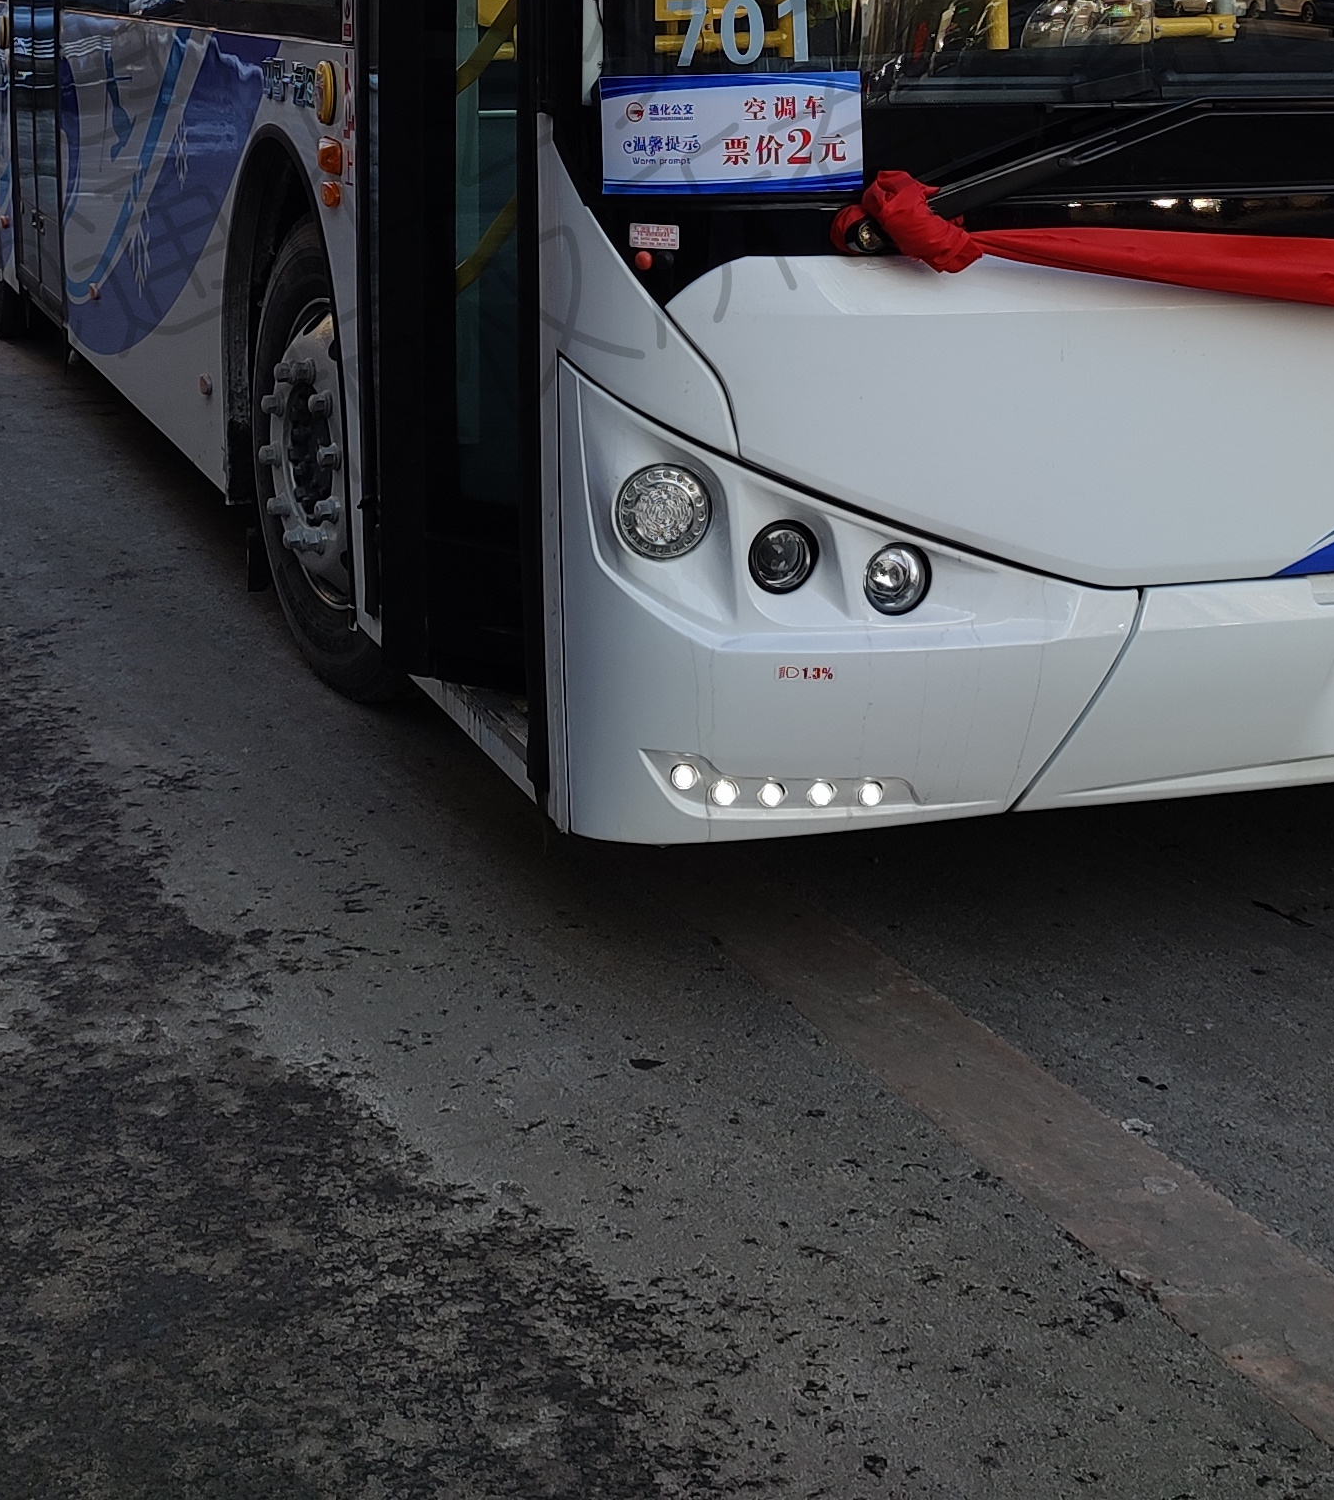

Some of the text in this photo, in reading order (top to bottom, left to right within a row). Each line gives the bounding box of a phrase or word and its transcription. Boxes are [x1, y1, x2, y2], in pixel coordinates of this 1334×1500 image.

[648, 103, 695, 116] 通化公交
[743, 95, 827, 122] 空调车
[623, 134, 701, 156] 温馨提示
[721, 128, 848, 167] 票价2元
[659, 157, 691, 166] prompt
[802, 666, 834, 680] 1.3%
